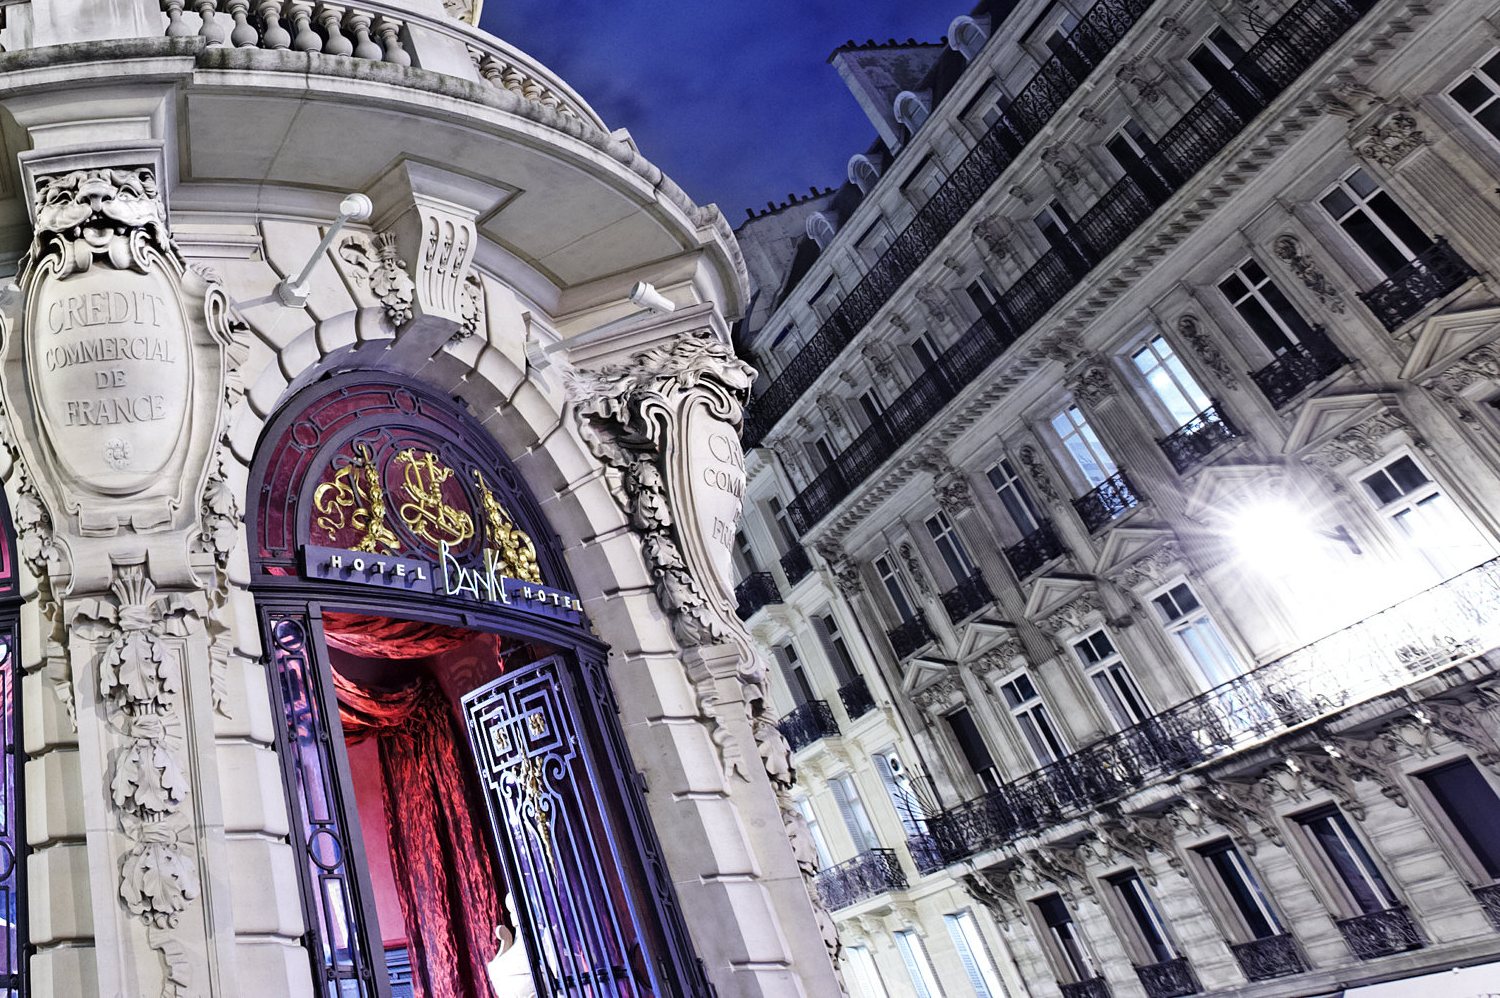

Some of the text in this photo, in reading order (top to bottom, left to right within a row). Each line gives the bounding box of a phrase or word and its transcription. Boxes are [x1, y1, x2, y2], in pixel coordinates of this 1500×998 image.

[48, 290, 165, 335] CREDIT
[45, 337, 176, 372] COMMERCIAL
[95, 369, 127, 390] DE
[64, 394, 167, 427] FRANCE
[331, 555, 426, 581] HOTEL
[523, 586, 584, 612] HOTEL
